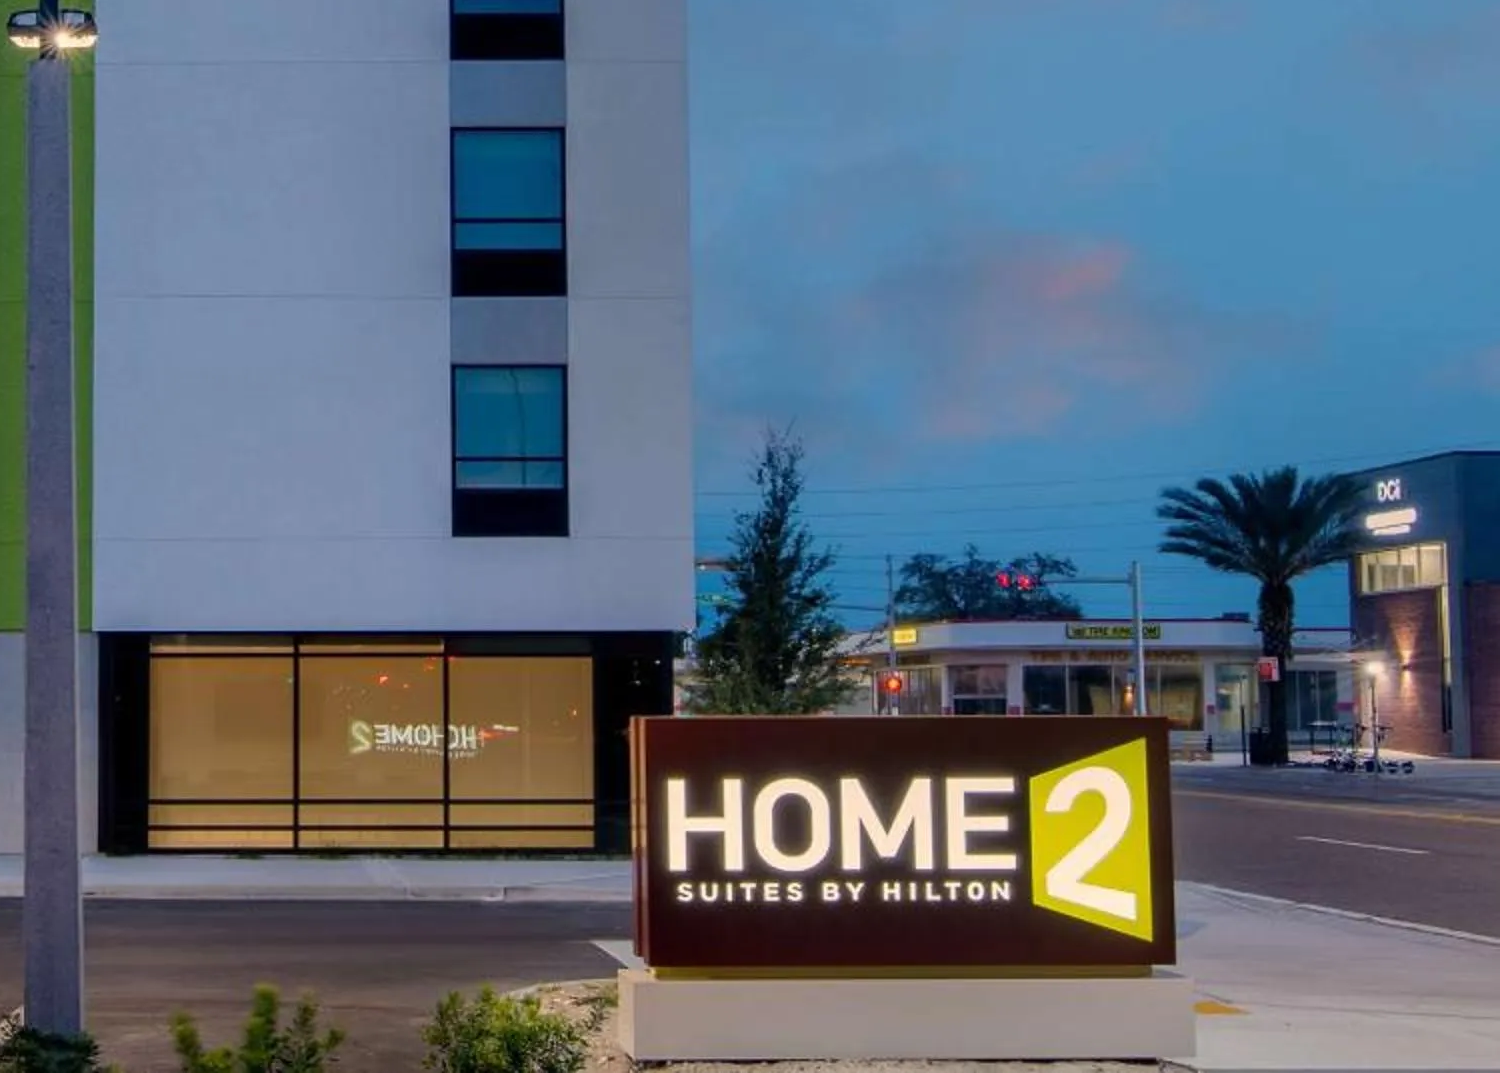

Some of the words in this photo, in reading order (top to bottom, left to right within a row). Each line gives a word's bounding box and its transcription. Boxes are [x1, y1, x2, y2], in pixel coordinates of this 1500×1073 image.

[666, 777, 1018, 873] HOME
[1044, 765, 1138, 922] 2
[676, 881, 804, 903] SUITES
[821, 881, 866, 903] BY
[882, 880, 1012, 902] HILTON
